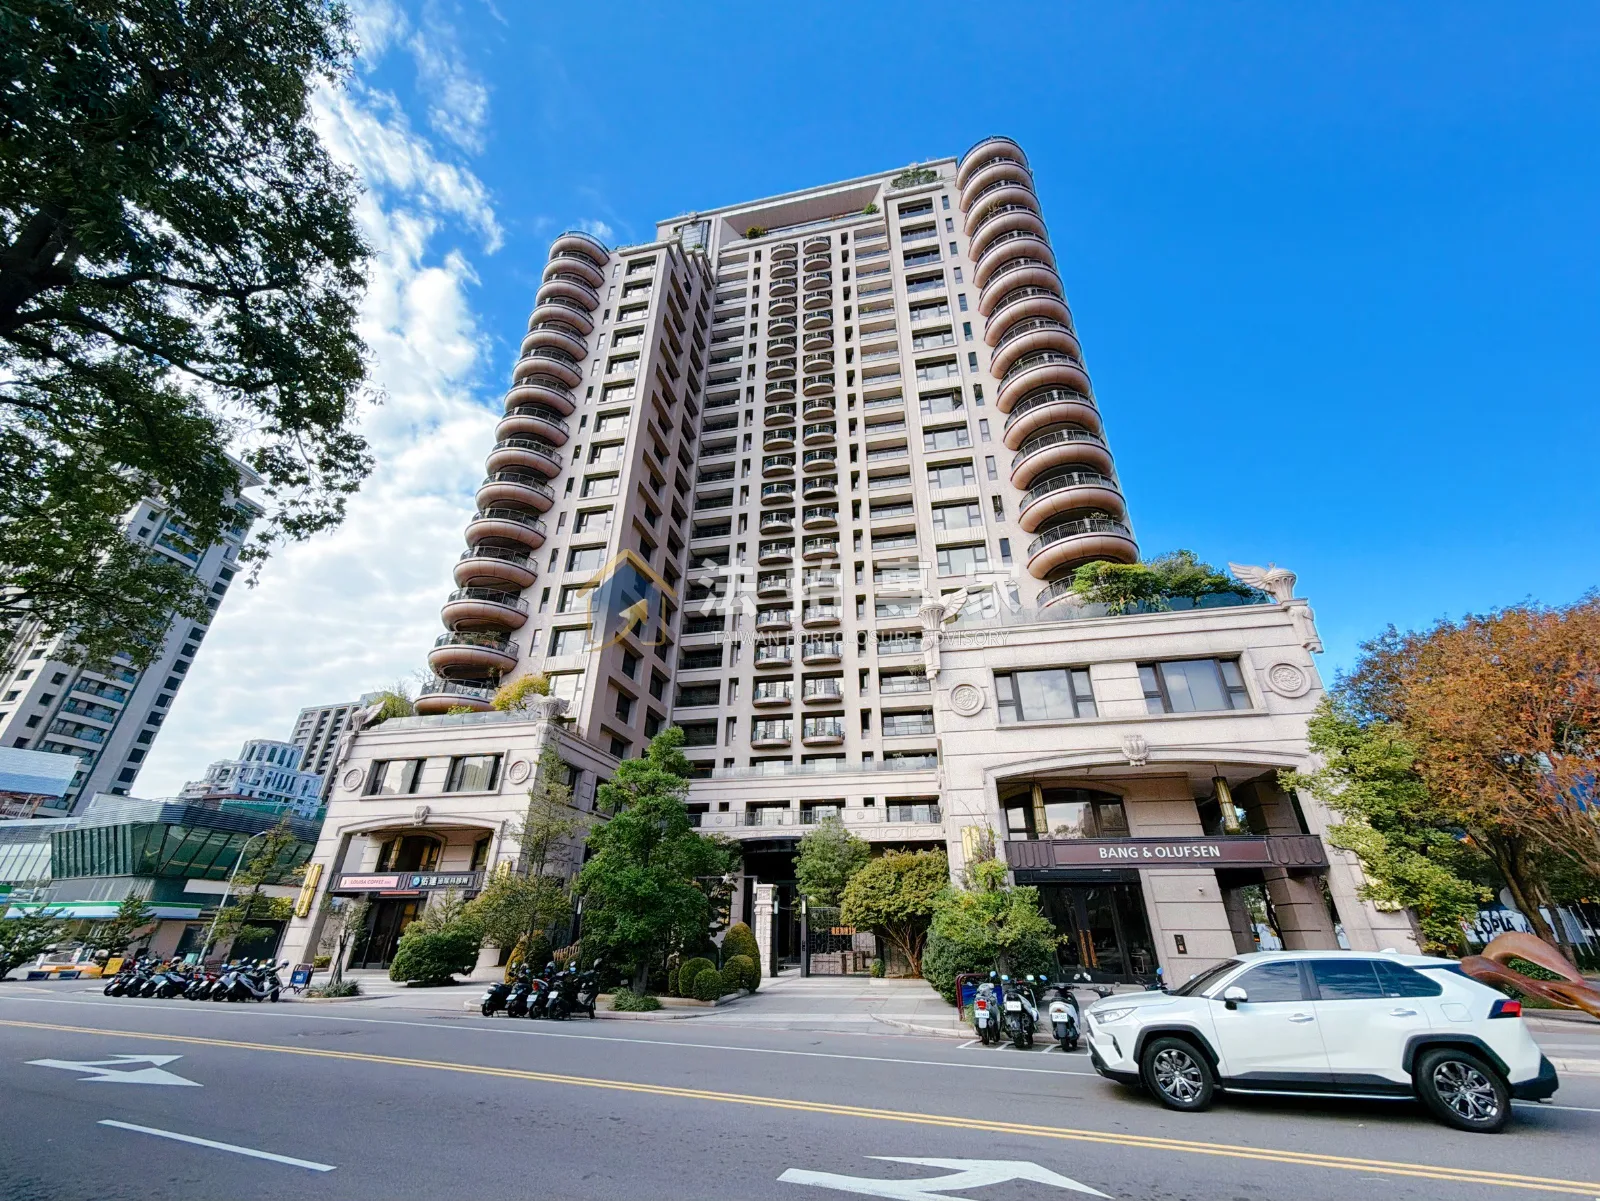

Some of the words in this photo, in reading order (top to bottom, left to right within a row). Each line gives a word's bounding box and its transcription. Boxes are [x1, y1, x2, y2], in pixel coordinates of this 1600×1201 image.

[1099, 847, 1139, 859] BANG
[1143, 847, 1152, 858] &
[1155, 846, 1220, 858] OLUFSEN
